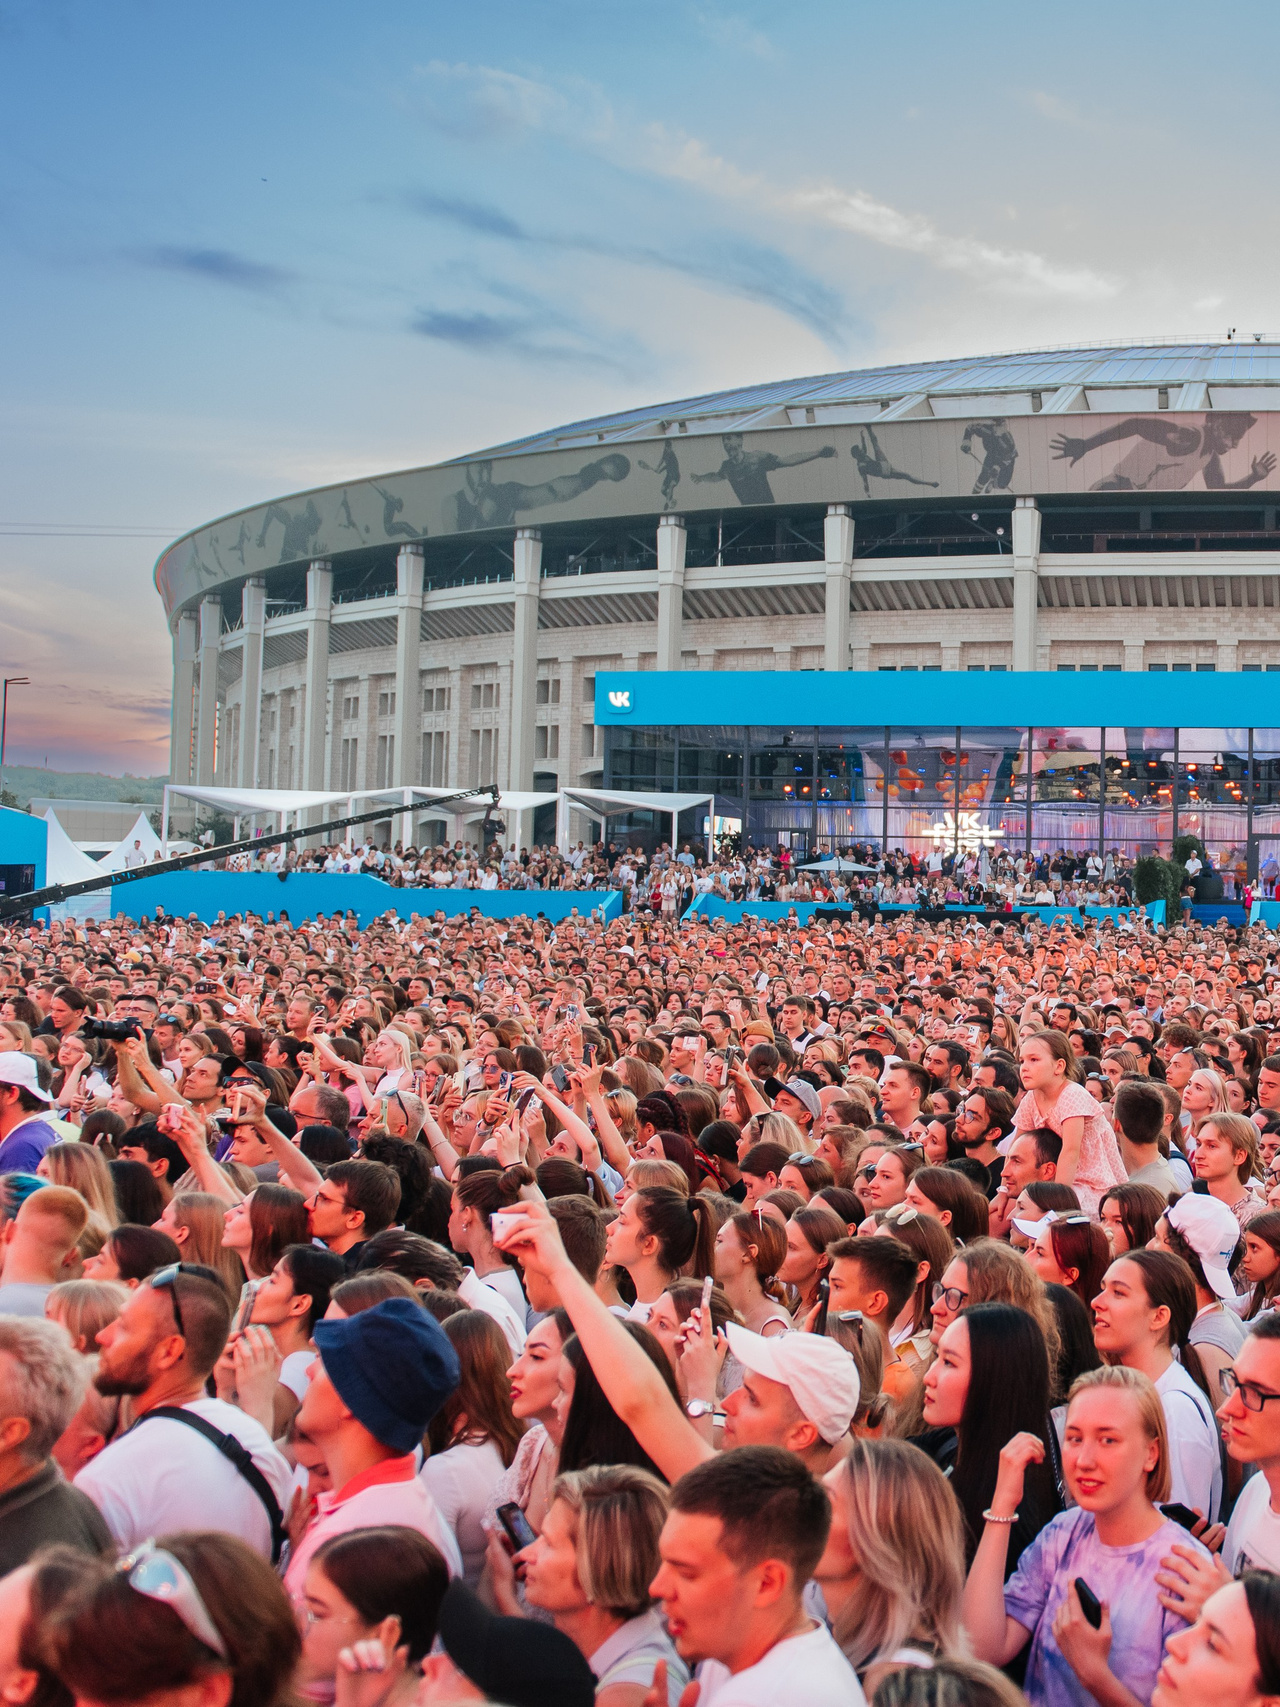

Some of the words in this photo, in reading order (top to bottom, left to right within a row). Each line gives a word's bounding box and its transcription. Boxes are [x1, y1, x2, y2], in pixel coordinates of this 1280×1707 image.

[608, 691, 631, 708] VK
[943, 812, 981, 830] VK
[921, 822, 1005, 847] fest
